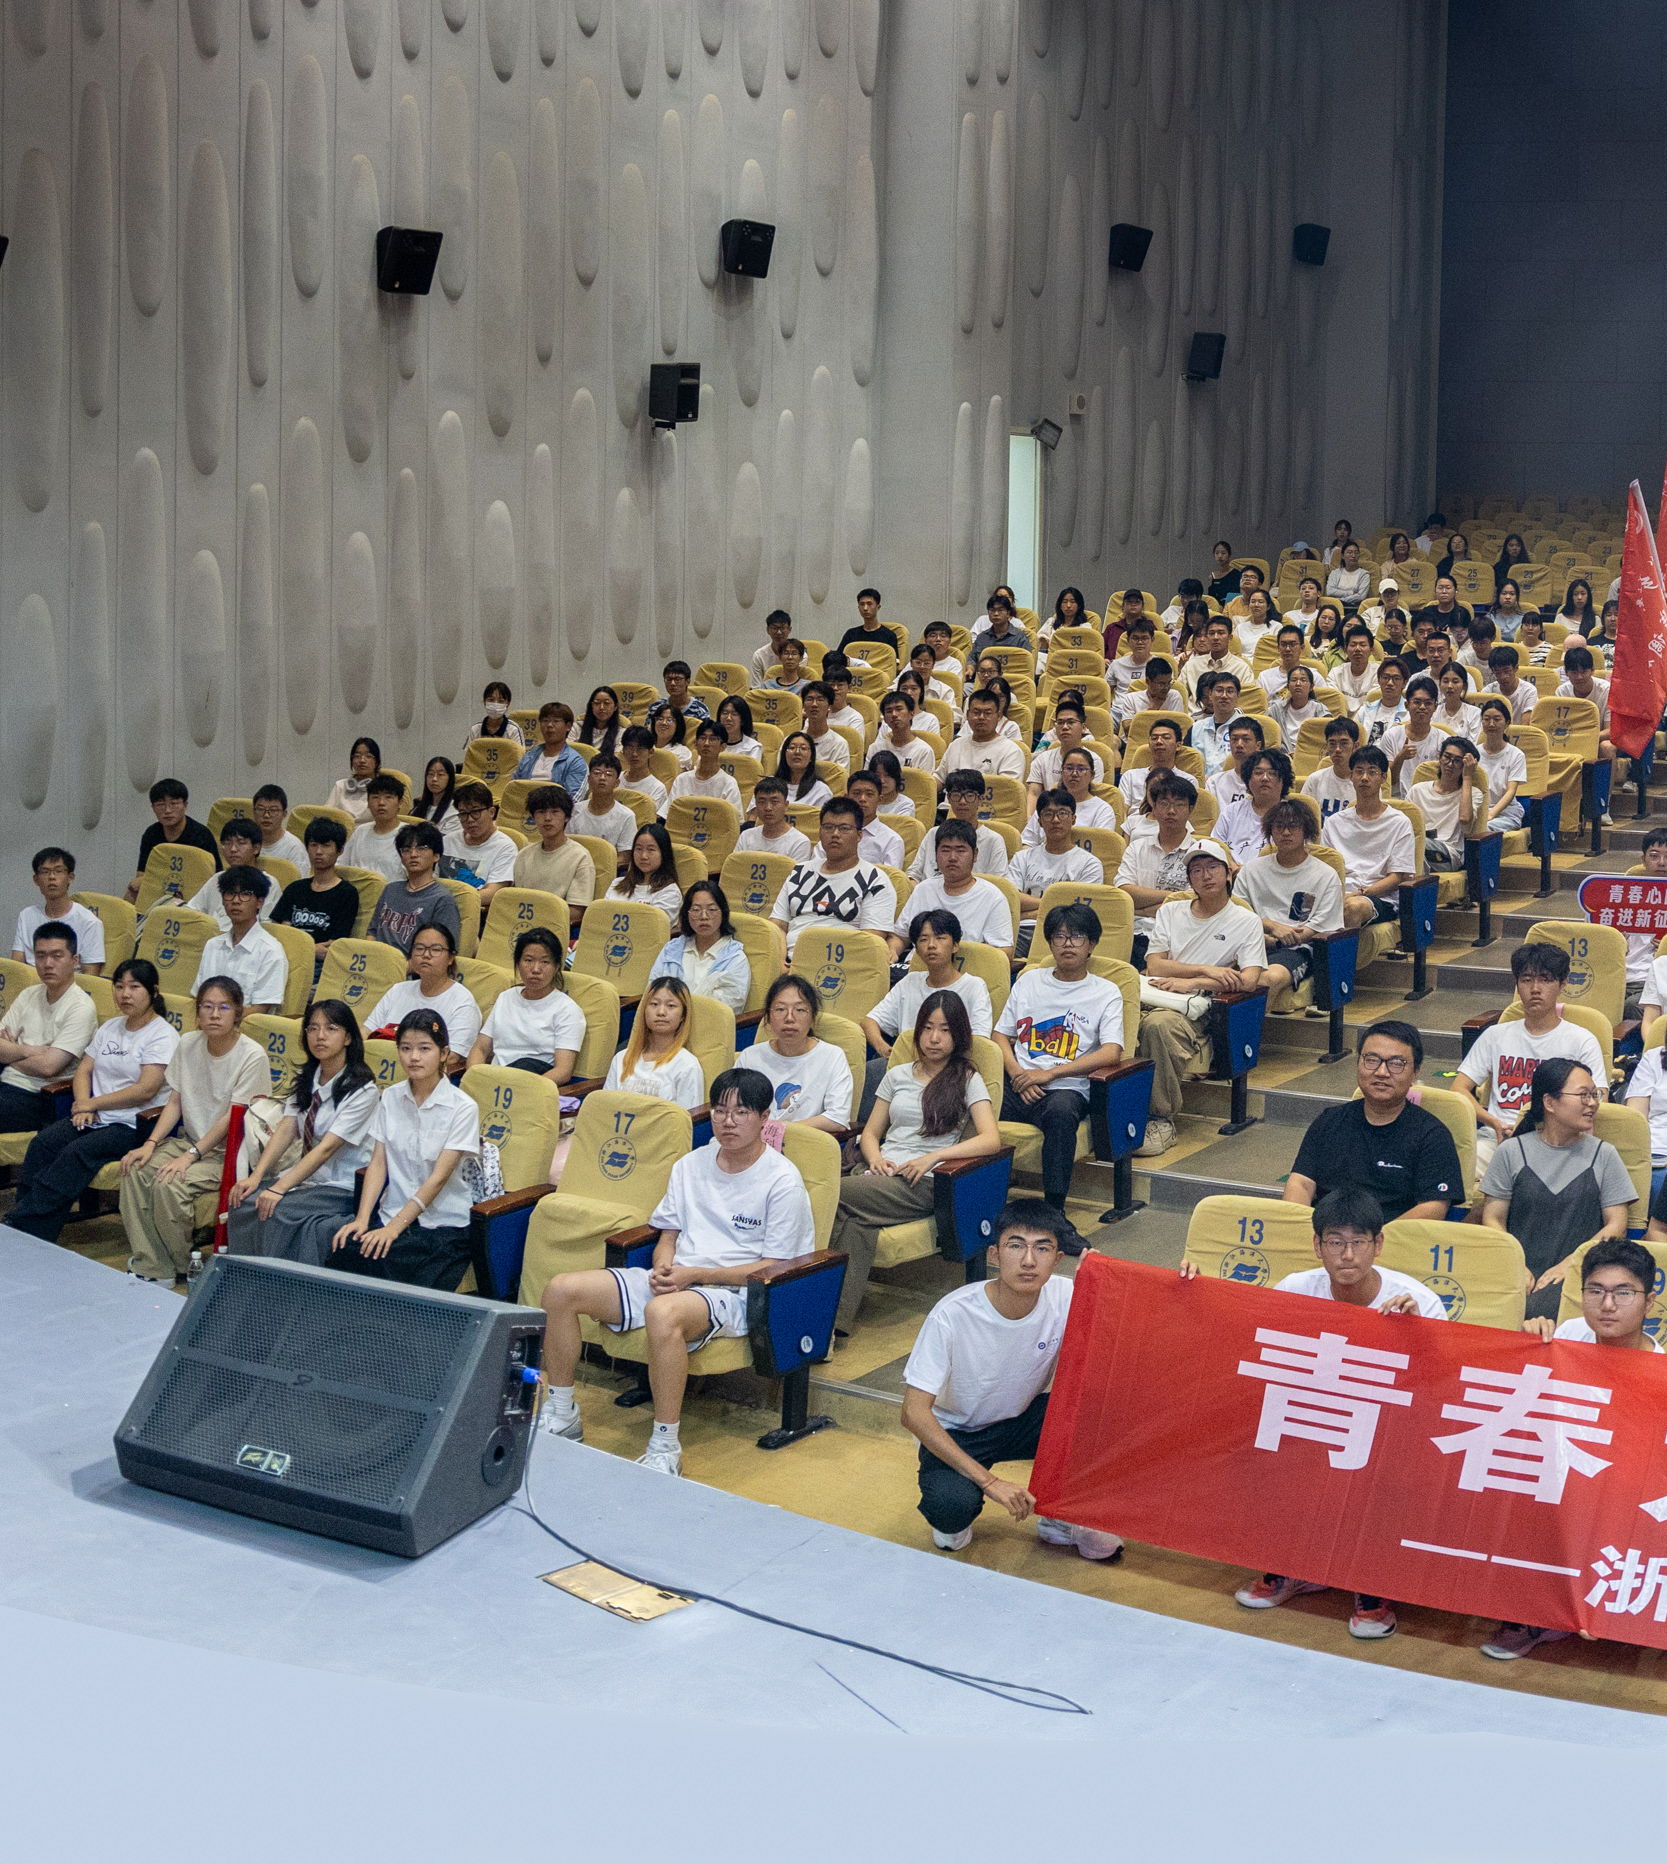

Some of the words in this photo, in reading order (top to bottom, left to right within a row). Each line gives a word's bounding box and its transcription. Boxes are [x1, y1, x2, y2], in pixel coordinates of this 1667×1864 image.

[1071, 636, 1082, 646] 33
[1068, 658, 1078, 669] 31
[716, 671, 727, 682] 39
[851, 676, 863, 687] 35
[622, 692, 634, 703] 39
[765, 699, 778, 710] 35
[1556, 706, 1569, 718] 17
[524, 719, 536, 730] 39
[486, 749, 498, 761] 35
[694, 808, 707, 821] 27
[170, 857, 183, 872] 33
[751, 864, 766, 880] 23
[518, 903, 534, 920] 25
[164, 919, 180, 936] 29
[612, 915, 629, 932] 23
[826, 944, 844, 962] 19
[1569, 938, 1588, 958] 13
[350, 953, 366, 972] 25
[268, 1033, 286, 1054] 23
[380, 1058, 397, 1080] 21
[494, 1086, 512, 1109] 19
[614, 1112, 635, 1134] 17
[1237, 1216, 1264, 1245] 13
[1430, 1245, 1454, 1272] 11
